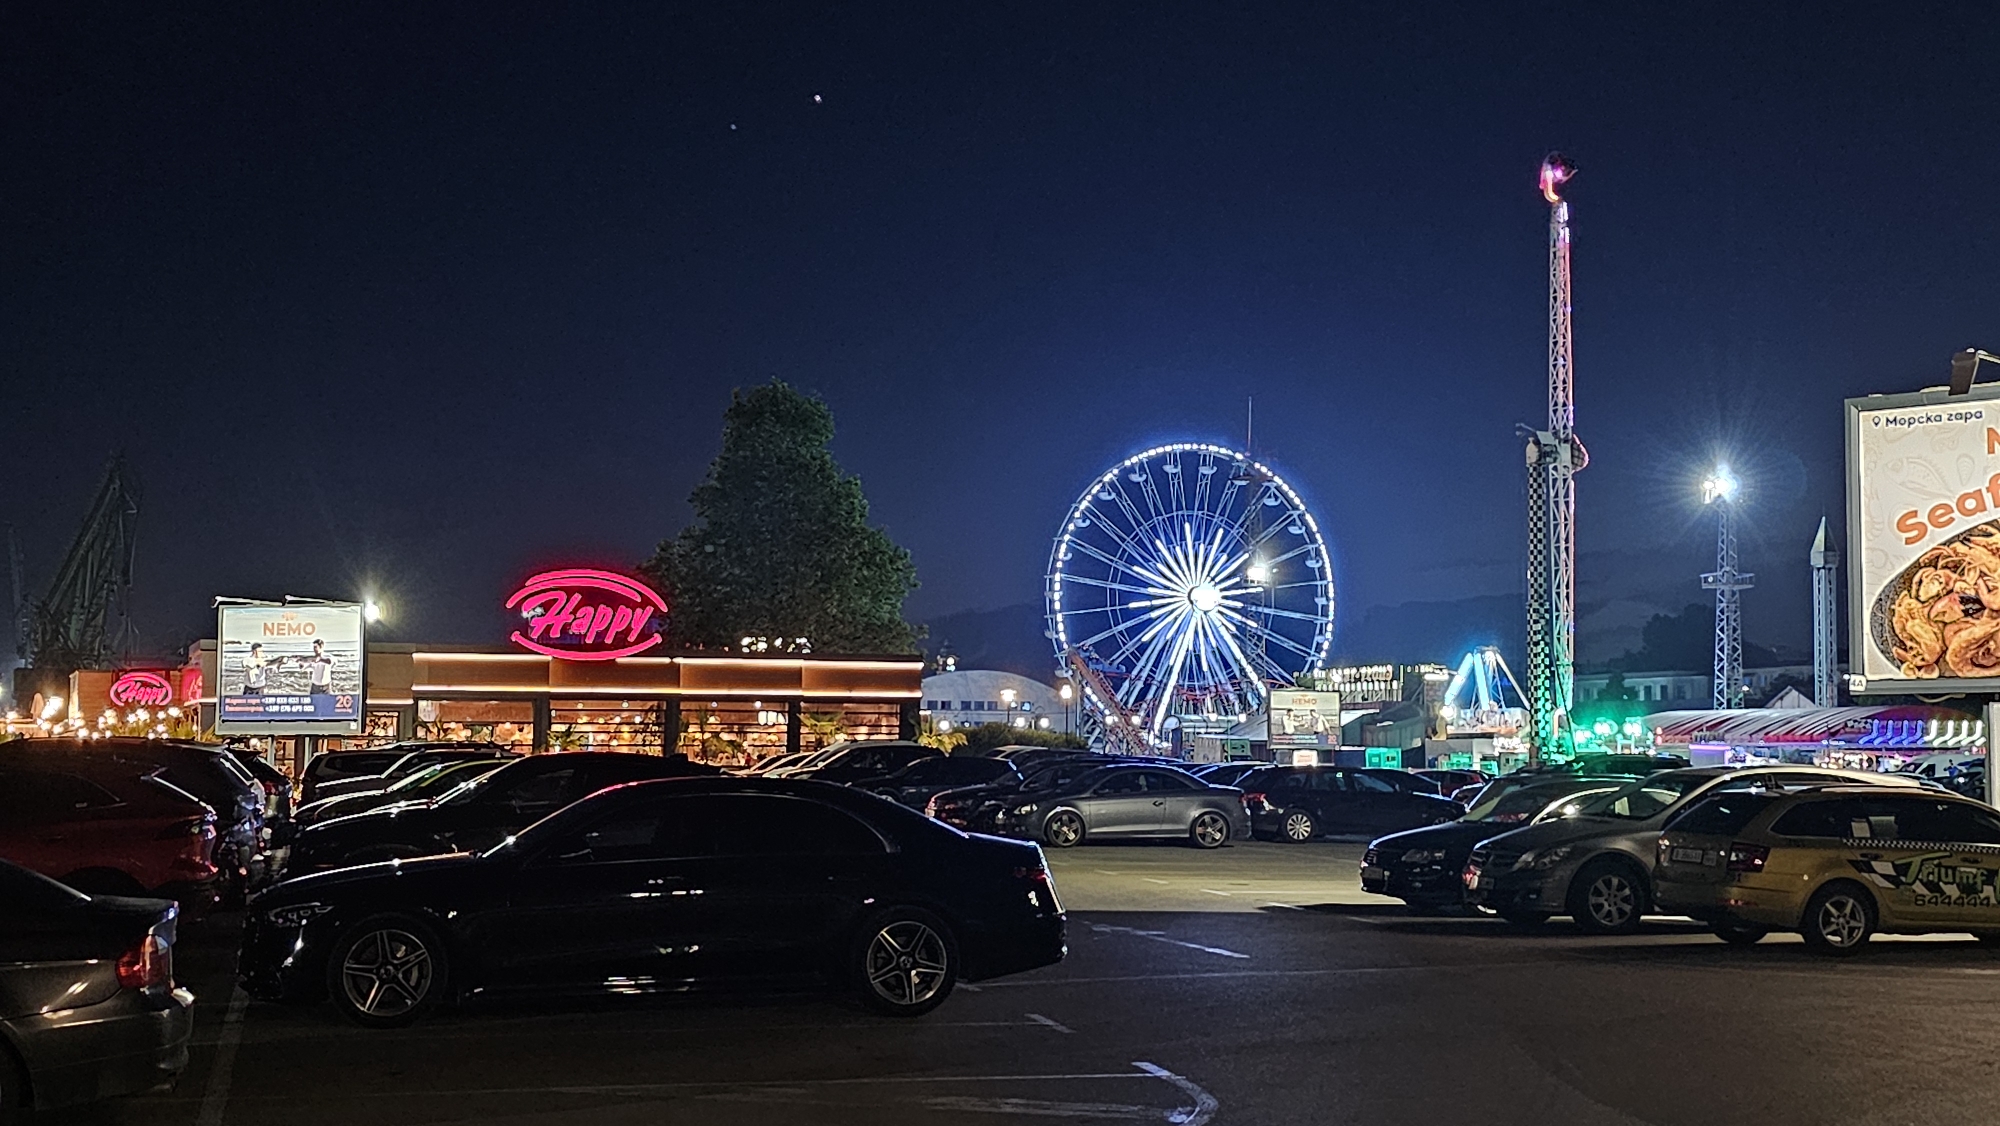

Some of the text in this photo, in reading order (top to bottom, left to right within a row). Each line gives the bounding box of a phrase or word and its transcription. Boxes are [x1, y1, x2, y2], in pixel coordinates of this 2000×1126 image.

[522, 590, 655, 644] Happy
[263, 622, 316, 637] NEMO
[117, 680, 167, 705] Happy
[1914, 893, 1991, 907] 644444
